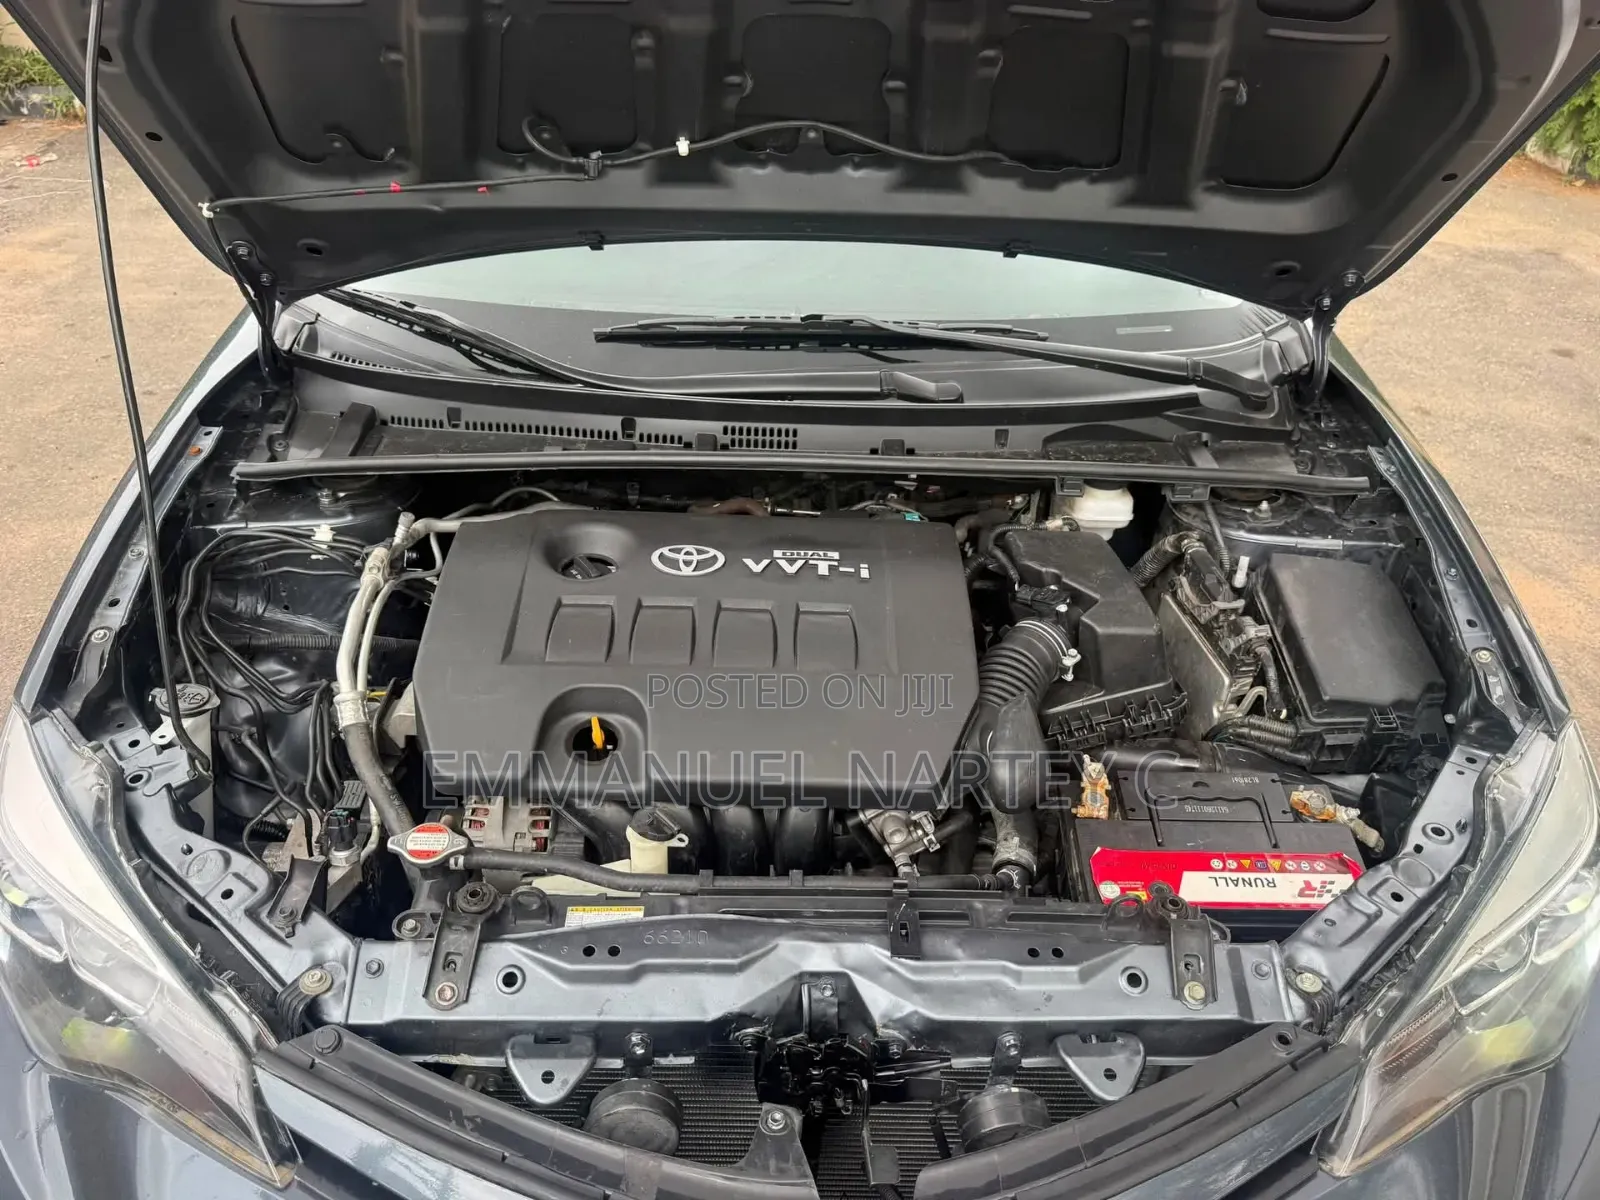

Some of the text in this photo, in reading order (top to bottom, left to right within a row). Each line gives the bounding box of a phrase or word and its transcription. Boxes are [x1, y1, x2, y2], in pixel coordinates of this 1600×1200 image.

[779, 550, 837, 559] DUAL
[742, 558, 870, 579] VVT-i
[1208, 875, 1277, 889] RUNALL
